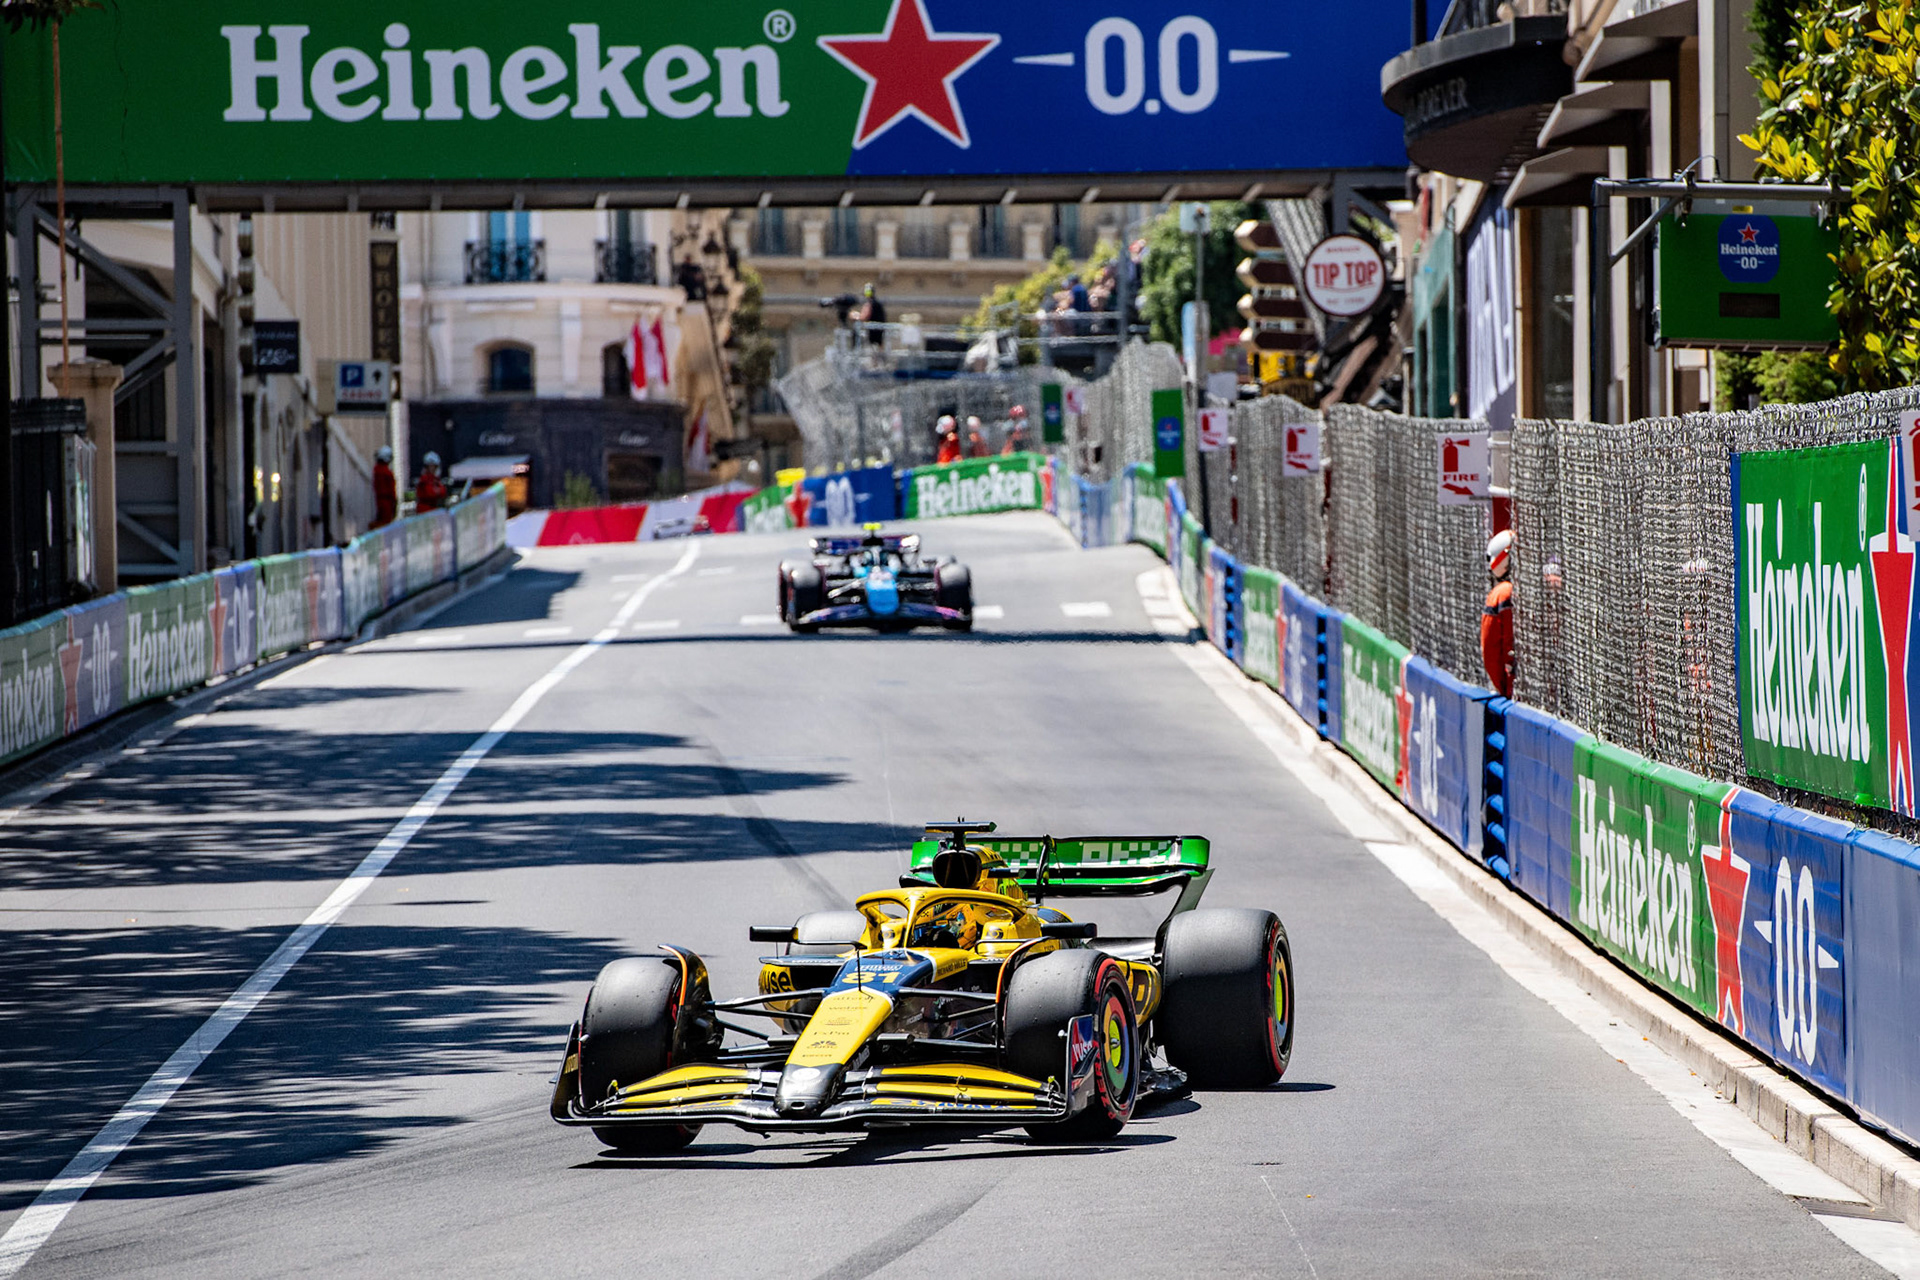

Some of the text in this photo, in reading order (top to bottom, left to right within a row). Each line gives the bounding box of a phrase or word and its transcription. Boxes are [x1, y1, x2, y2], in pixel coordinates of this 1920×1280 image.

[1084, 15, 1219, 115] 0.0
[1312, 260, 1378, 286] TIP TOP
[1720, 243, 1777, 256] Heineken
[915, 463, 1036, 519] Heineken
[1443, 473, 1480, 482] FIRE
[128, 602, 206, 701] Heineken
[1746, 498, 1870, 765] Heineken
[0, 648, 56, 757] neken
[1578, 774, 1697, 993] Heineken
[842, 971, 901, 984] 81
